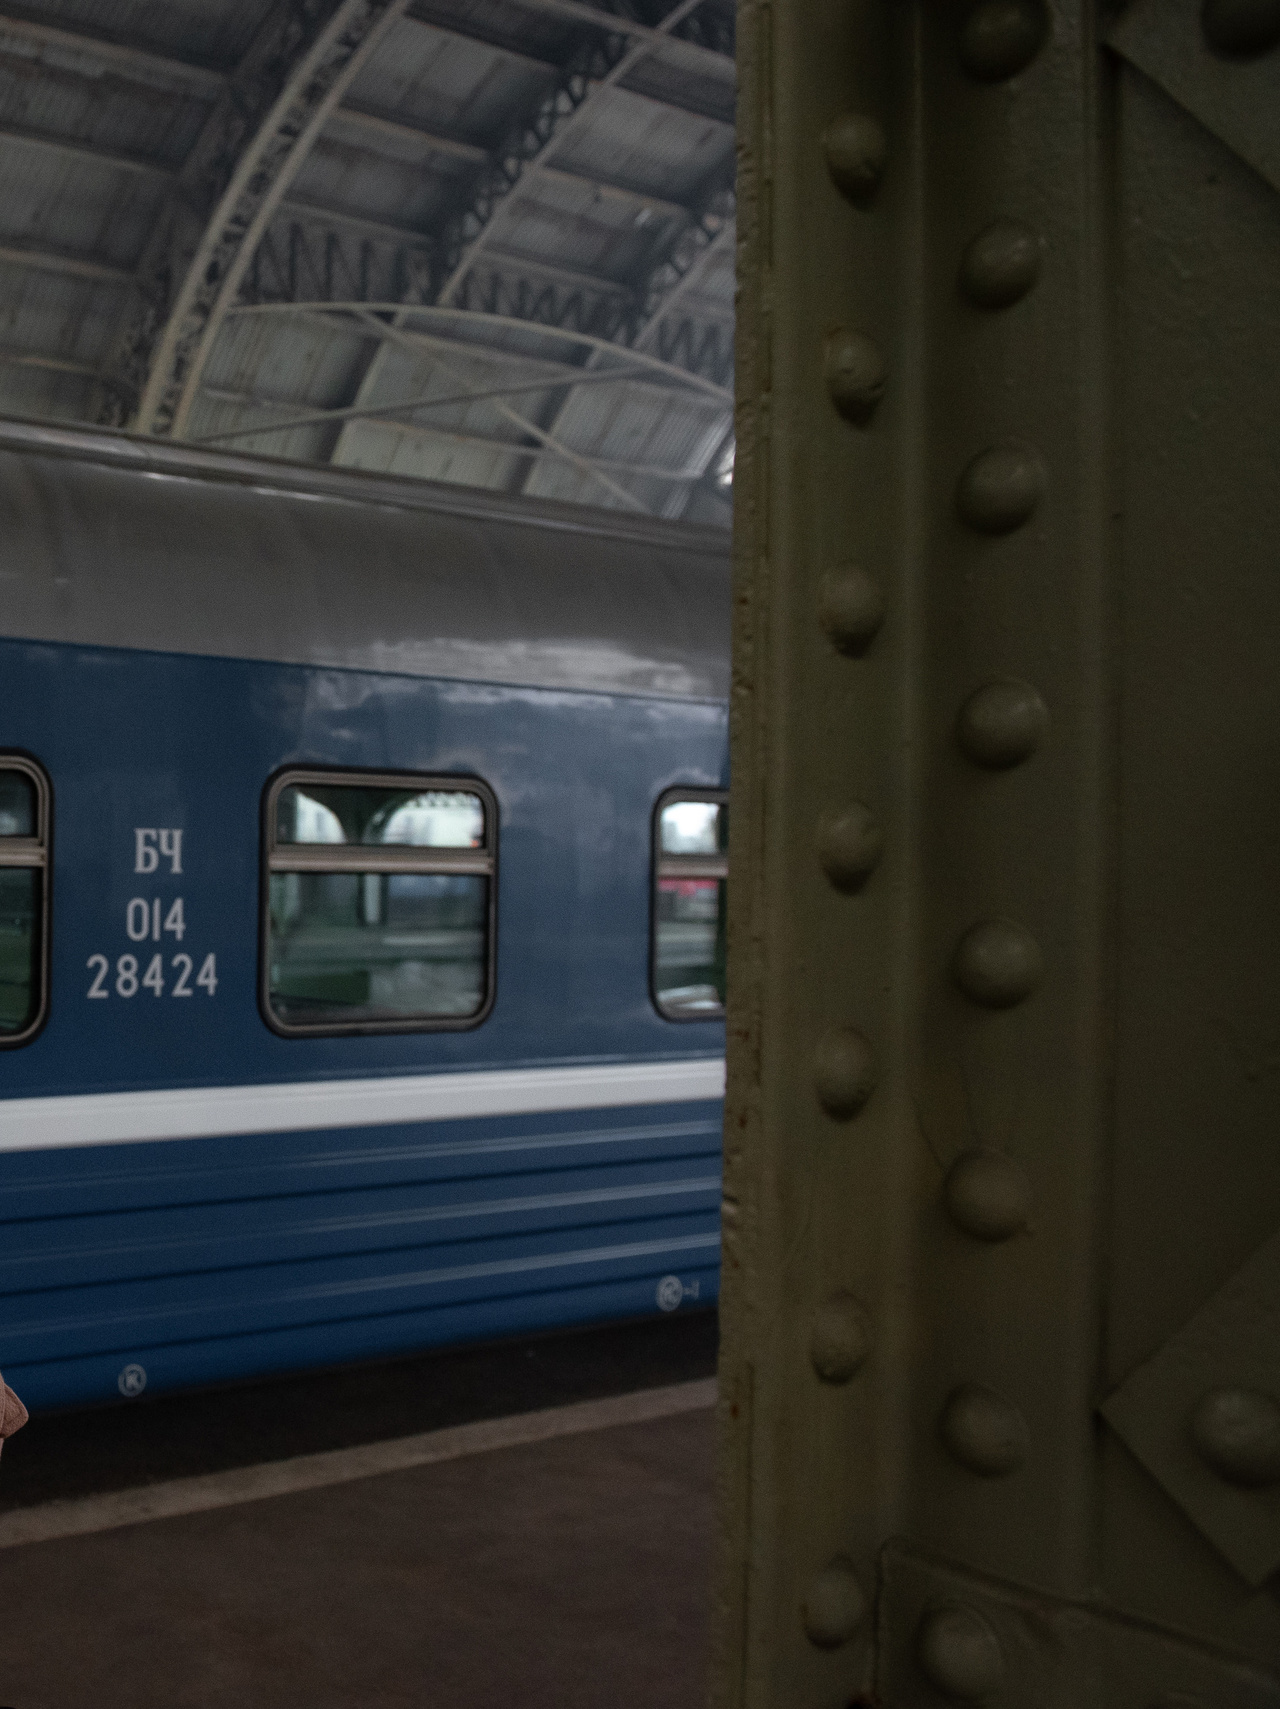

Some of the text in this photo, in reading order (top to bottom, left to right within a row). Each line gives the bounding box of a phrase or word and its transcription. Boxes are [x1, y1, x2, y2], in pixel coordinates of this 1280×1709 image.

[134, 827, 184, 874] БЧ
[126, 897, 186, 942] 014
[86, 953, 218, 999] 28424
